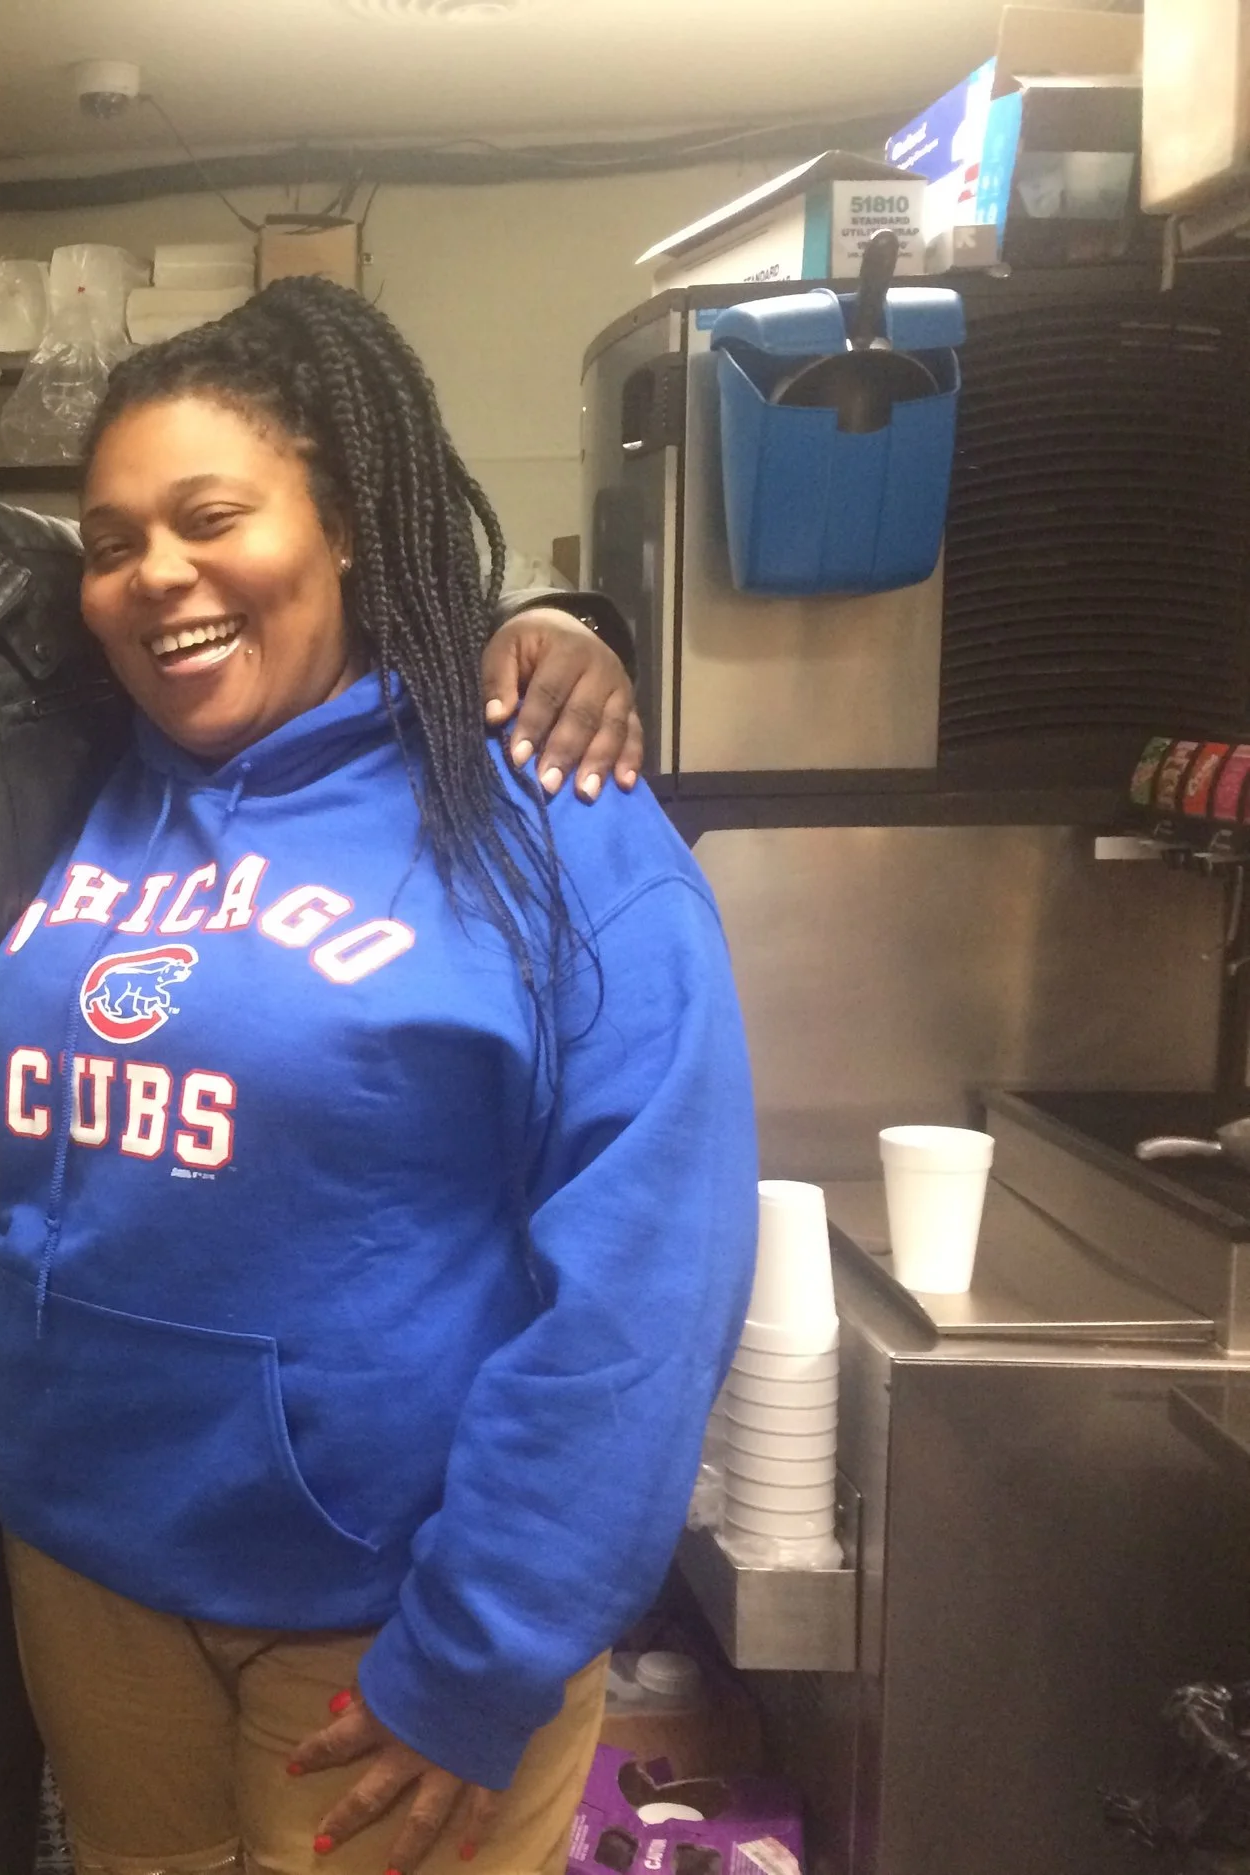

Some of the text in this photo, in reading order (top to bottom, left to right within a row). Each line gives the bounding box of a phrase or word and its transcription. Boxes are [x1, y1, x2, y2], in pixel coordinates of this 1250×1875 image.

[851, 196, 909, 213] 51810
[851, 217, 910, 225] STANDARD
[6, 1045, 237, 1170] CUBS
